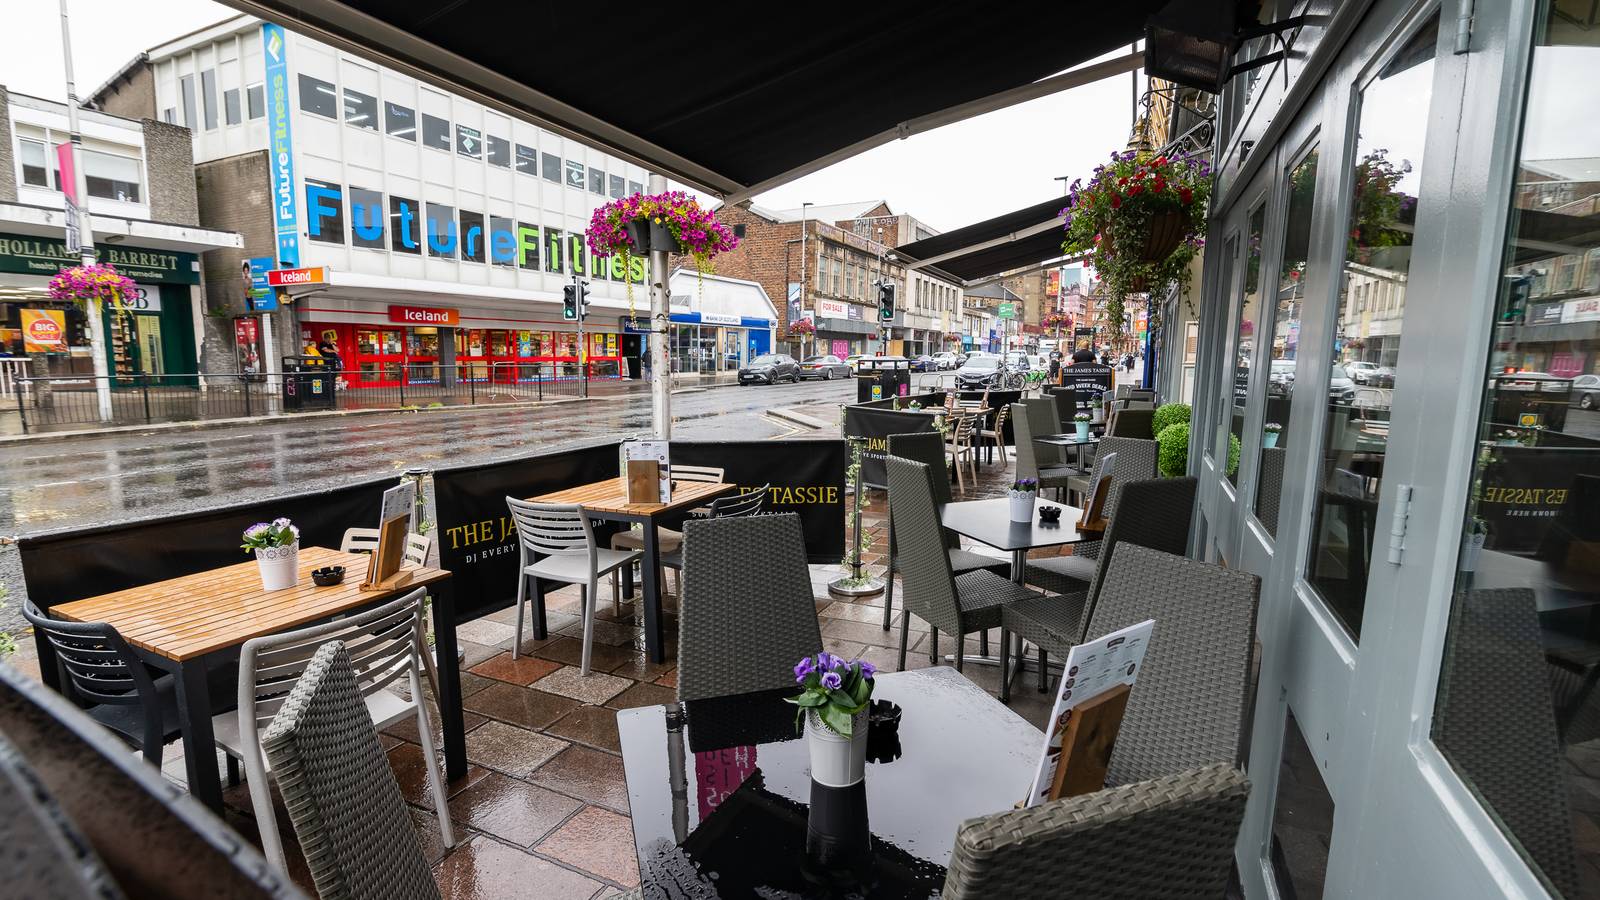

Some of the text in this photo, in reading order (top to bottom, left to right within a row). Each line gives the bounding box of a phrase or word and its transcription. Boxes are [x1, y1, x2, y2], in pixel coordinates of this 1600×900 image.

[273, 73, 293, 221] FutureFitness
[306, 185, 652, 282] FutureFitnes
[110, 250, 178, 270] BARRETT
[280, 271, 311, 283] Iceland
[823, 303, 842, 312] FOR SALE
[405, 309, 449, 322] Iceland
[34, 323, 55, 331] BIG
[1091, 383, 1107, 391] DEALS
[868, 438, 886, 451] JAM
[768, 486, 838, 504] TASSIE
[446, 519, 494, 550] THE
[466, 554, 477, 564] DJ
[482, 543, 516, 559] EVERY
